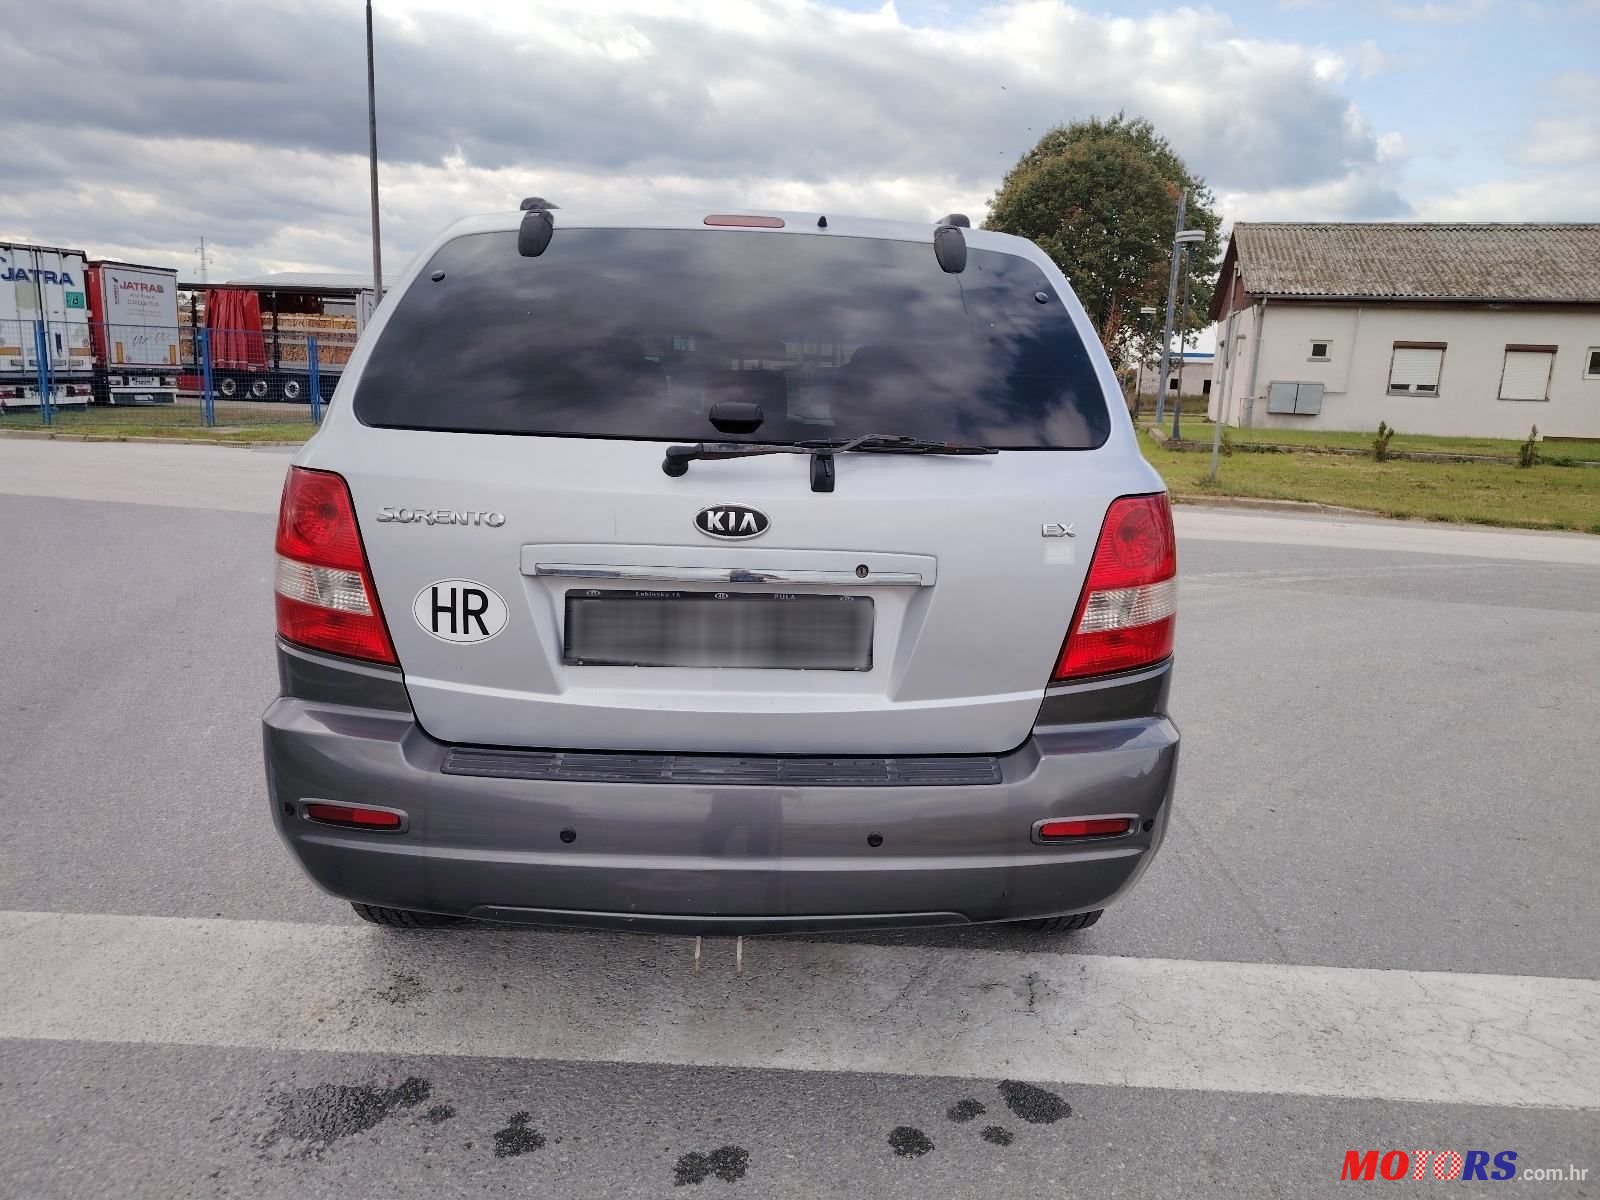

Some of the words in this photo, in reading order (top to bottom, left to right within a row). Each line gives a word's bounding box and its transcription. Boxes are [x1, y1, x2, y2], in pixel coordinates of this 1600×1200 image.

[1, 267, 76, 286] JATRA
[120, 281, 164, 293] JATRAS
[376, 506, 506, 528] SORENTO
[706, 510, 759, 533] KIA
[1041, 523, 1077, 538] EX
[431, 586, 490, 636] HR
